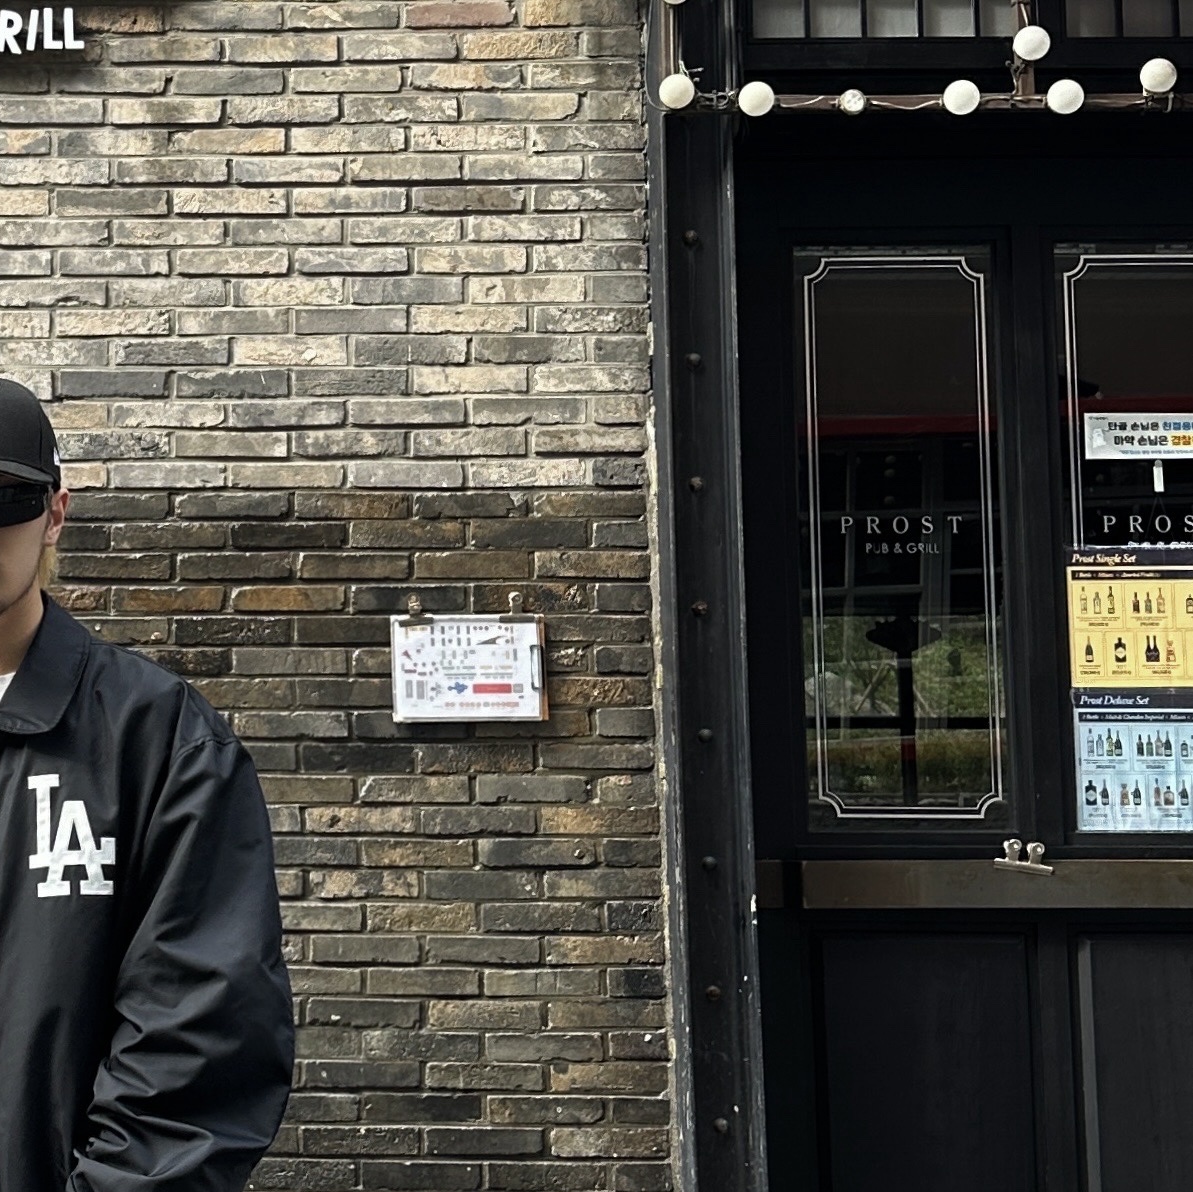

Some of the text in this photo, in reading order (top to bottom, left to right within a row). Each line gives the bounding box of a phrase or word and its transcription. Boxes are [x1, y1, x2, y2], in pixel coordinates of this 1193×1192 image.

[1130, 421, 1160, 432] 손님은
[1114, 435, 1193, 447] 마약 손님은 경찰
[840, 515, 963, 535] PROST
[865, 542, 940, 554] PUB & GRILL
[1072, 553, 1137, 566] Prost Single Set
[1079, 695, 1103, 705] Prost
[1136, 695, 1150, 705] Set
[27, 773, 117, 898] LA
